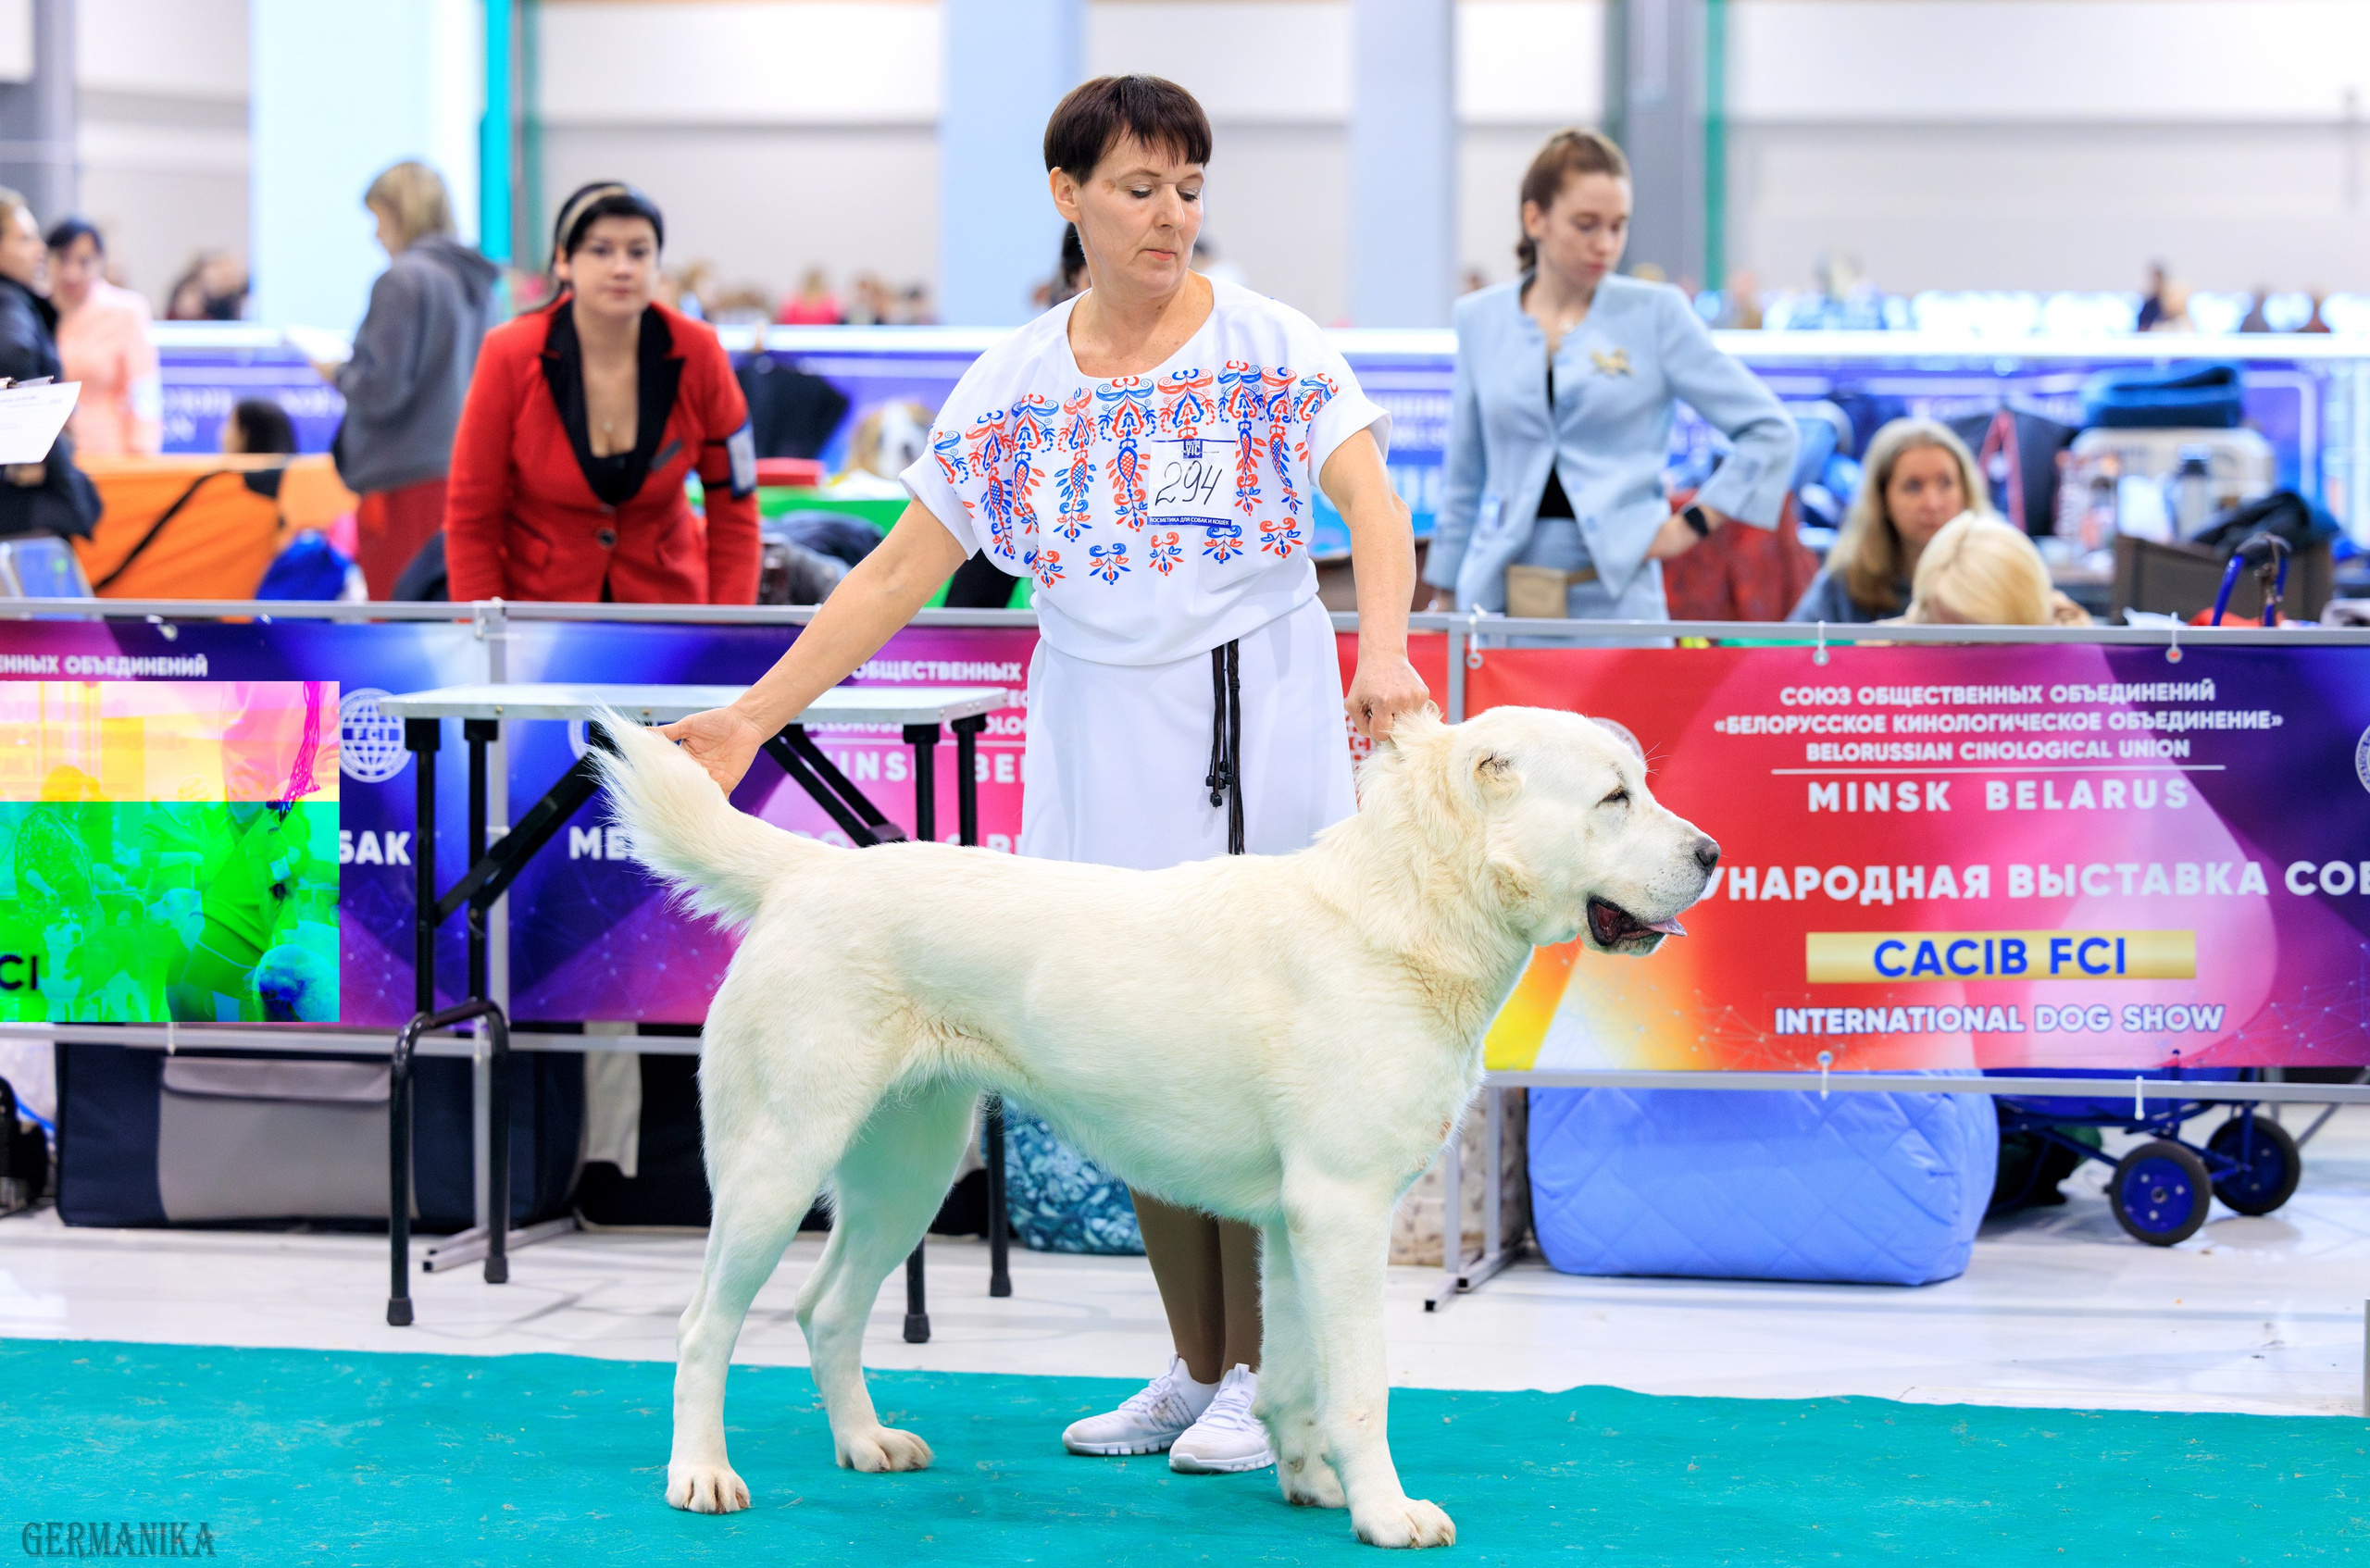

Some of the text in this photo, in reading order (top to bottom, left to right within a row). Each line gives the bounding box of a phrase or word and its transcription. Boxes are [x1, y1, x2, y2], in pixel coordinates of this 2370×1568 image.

[1154, 460, 1223, 506] 294
[64, 653, 208, 678] ОБЪЕДИНЕНИЙ
[1779, 678, 2215, 708] СОЮЗ ОБЩЕСТВЕННЫХ ОБЪЕДИНЕНИЙ
[1715, 710, 2284, 734] «БЕЛОРУССКОЕ КИНОЛОГИЧЕСКОЕ ОБЪЕДИНЕНИЕ»
[1806, 739, 2190, 762] BELORUSSIAN CINOLOGICAL UNION
[1808, 778, 2189, 812] MINSK BELARUS
[2007, 861, 2270, 898] ВЫСТАВКА
[1873, 937, 2127, 977] CACIB FCI
[1775, 1002, 2226, 1035] INTERNATIONAL DOG SHOW
